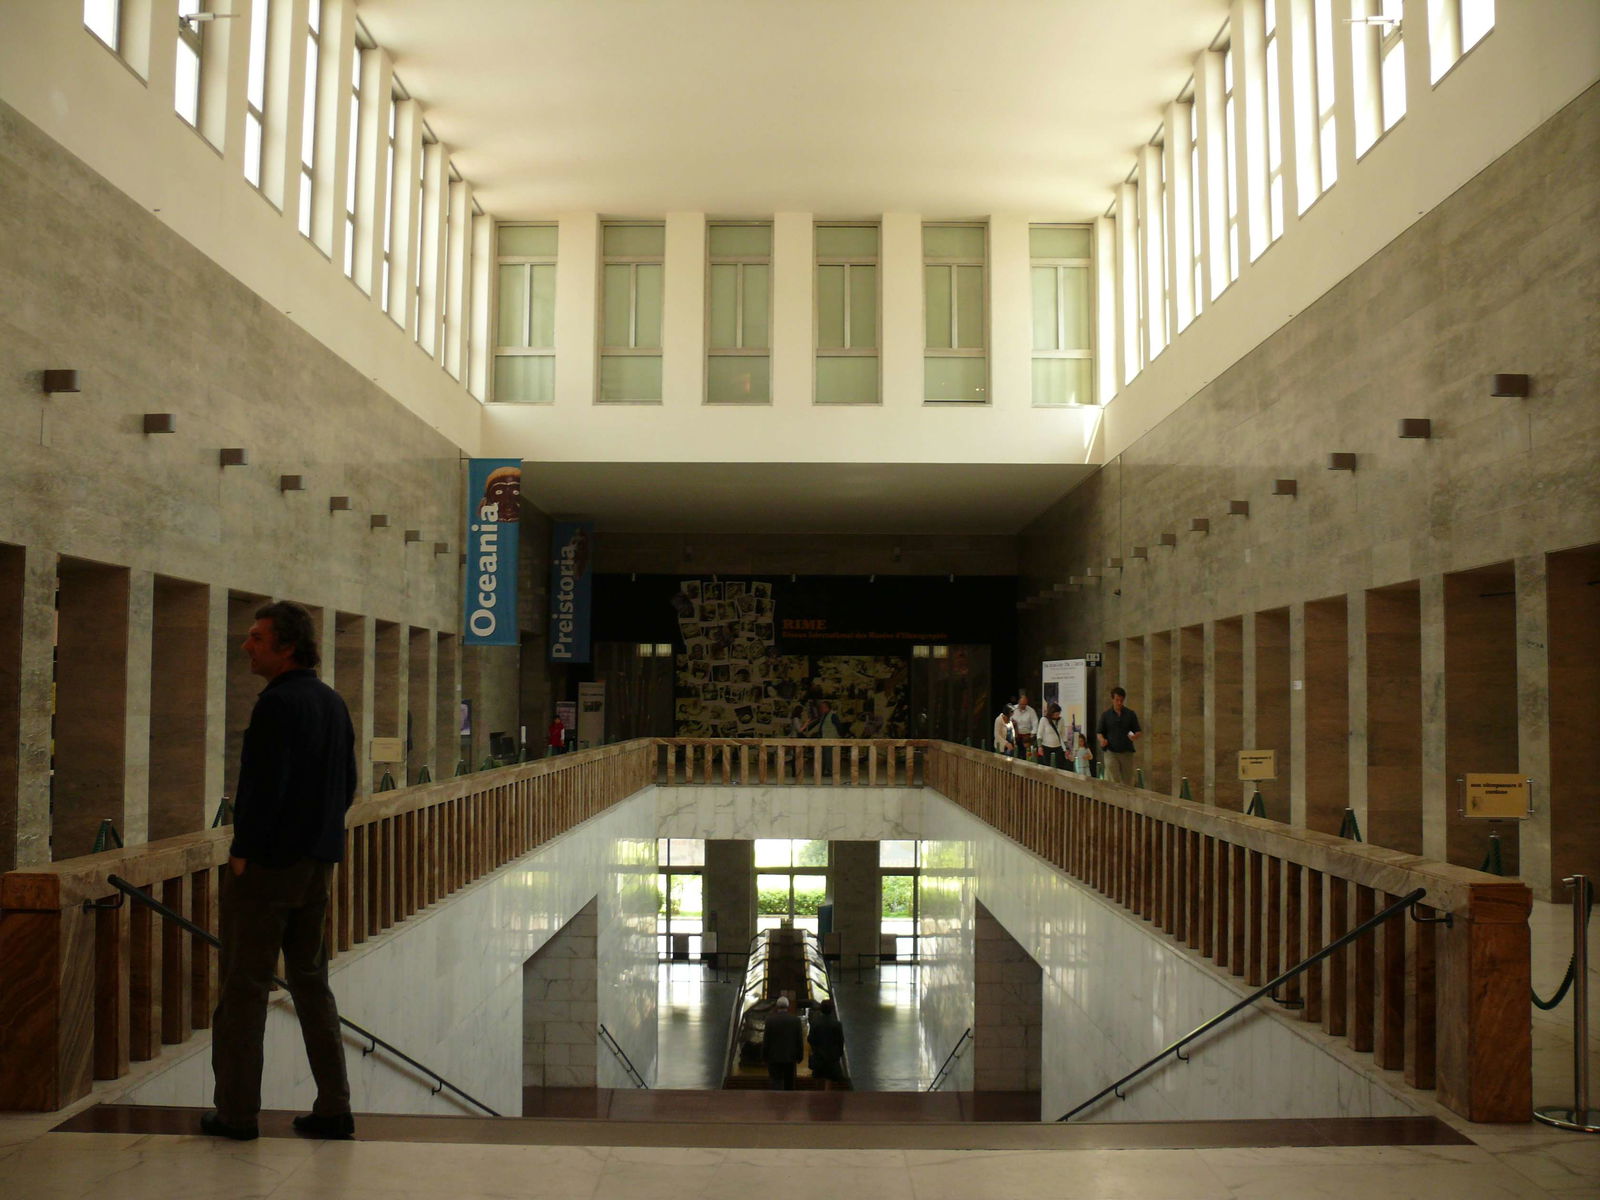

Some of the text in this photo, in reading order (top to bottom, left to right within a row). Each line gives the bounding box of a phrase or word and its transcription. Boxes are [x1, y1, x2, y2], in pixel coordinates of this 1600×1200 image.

[470, 502, 499, 637] Oceania
[552, 537, 579, 658] Preistoria
[783, 619, 827, 631] RIME
